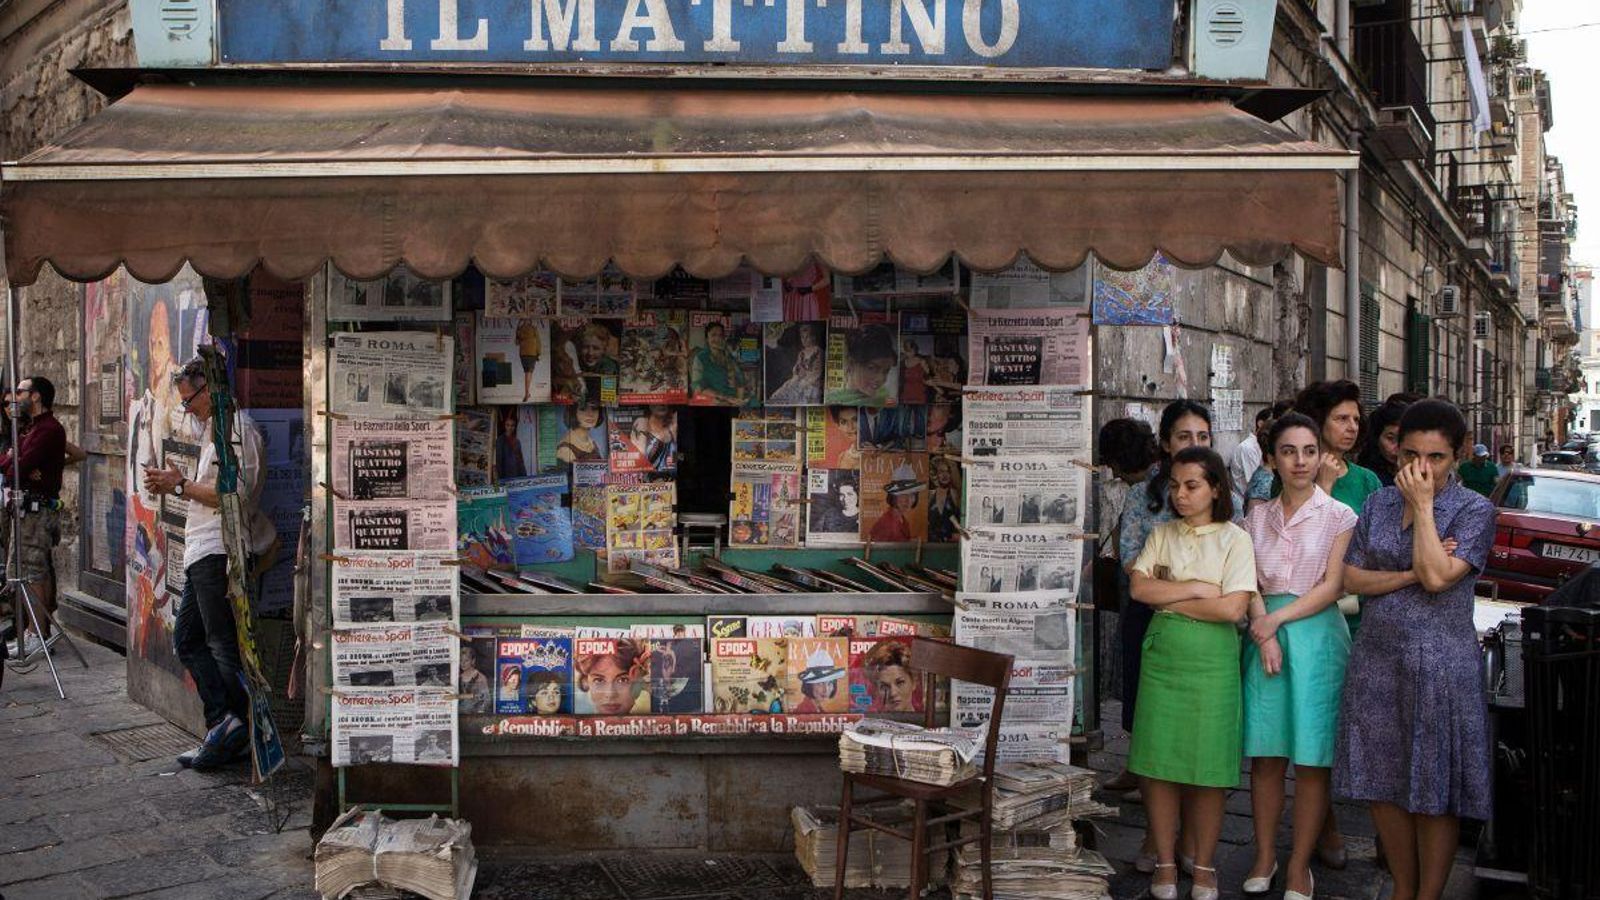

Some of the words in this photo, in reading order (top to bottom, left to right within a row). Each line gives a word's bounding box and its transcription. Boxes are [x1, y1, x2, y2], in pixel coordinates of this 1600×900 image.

[379, 0, 488, 52] IL
[523, 0, 1021, 58] MATTINO
[367, 339, 416, 351] ROMA
[990, 344, 1037, 352] BASTANO
[990, 354, 1037, 363] QUATTRO
[994, 365, 1024, 373] PUNTI
[411, 421, 430, 432] Sport
[354, 449, 402, 457] BASTANO
[354, 458, 402, 468] QUATTRO
[1000, 462, 1048, 471] ROMA
[358, 469, 390, 478] PUNTI
[355, 517, 402, 526] BASTANO
[355, 527, 402, 537] QUATTRO
[360, 538, 390, 547] PUNTI
[1000, 533, 1048, 543] ROMA
[387, 557, 415, 570] Sport
[992, 601, 1039, 610] ROMA
[751, 621, 817, 638] GRAIA
[821, 618, 855, 633] EPOCA
[881, 621, 916, 636] EPOCA
[385, 630, 412, 643] Sport
[501, 642, 536, 656] EPOCA
[579, 641, 615, 655] EPOCA
[719, 641, 755, 656] EPOCA
[388, 693, 416, 707] Sport
[498, 718, 576, 736] Repubblica
[578, 719, 593, 736] la
[594, 718, 672, 736] Repubblica
[675, 719, 689, 735] la
[691, 717, 768, 735] Repubblica
[770, 716, 785, 734] la
[997, 733, 1029, 743] OMA
